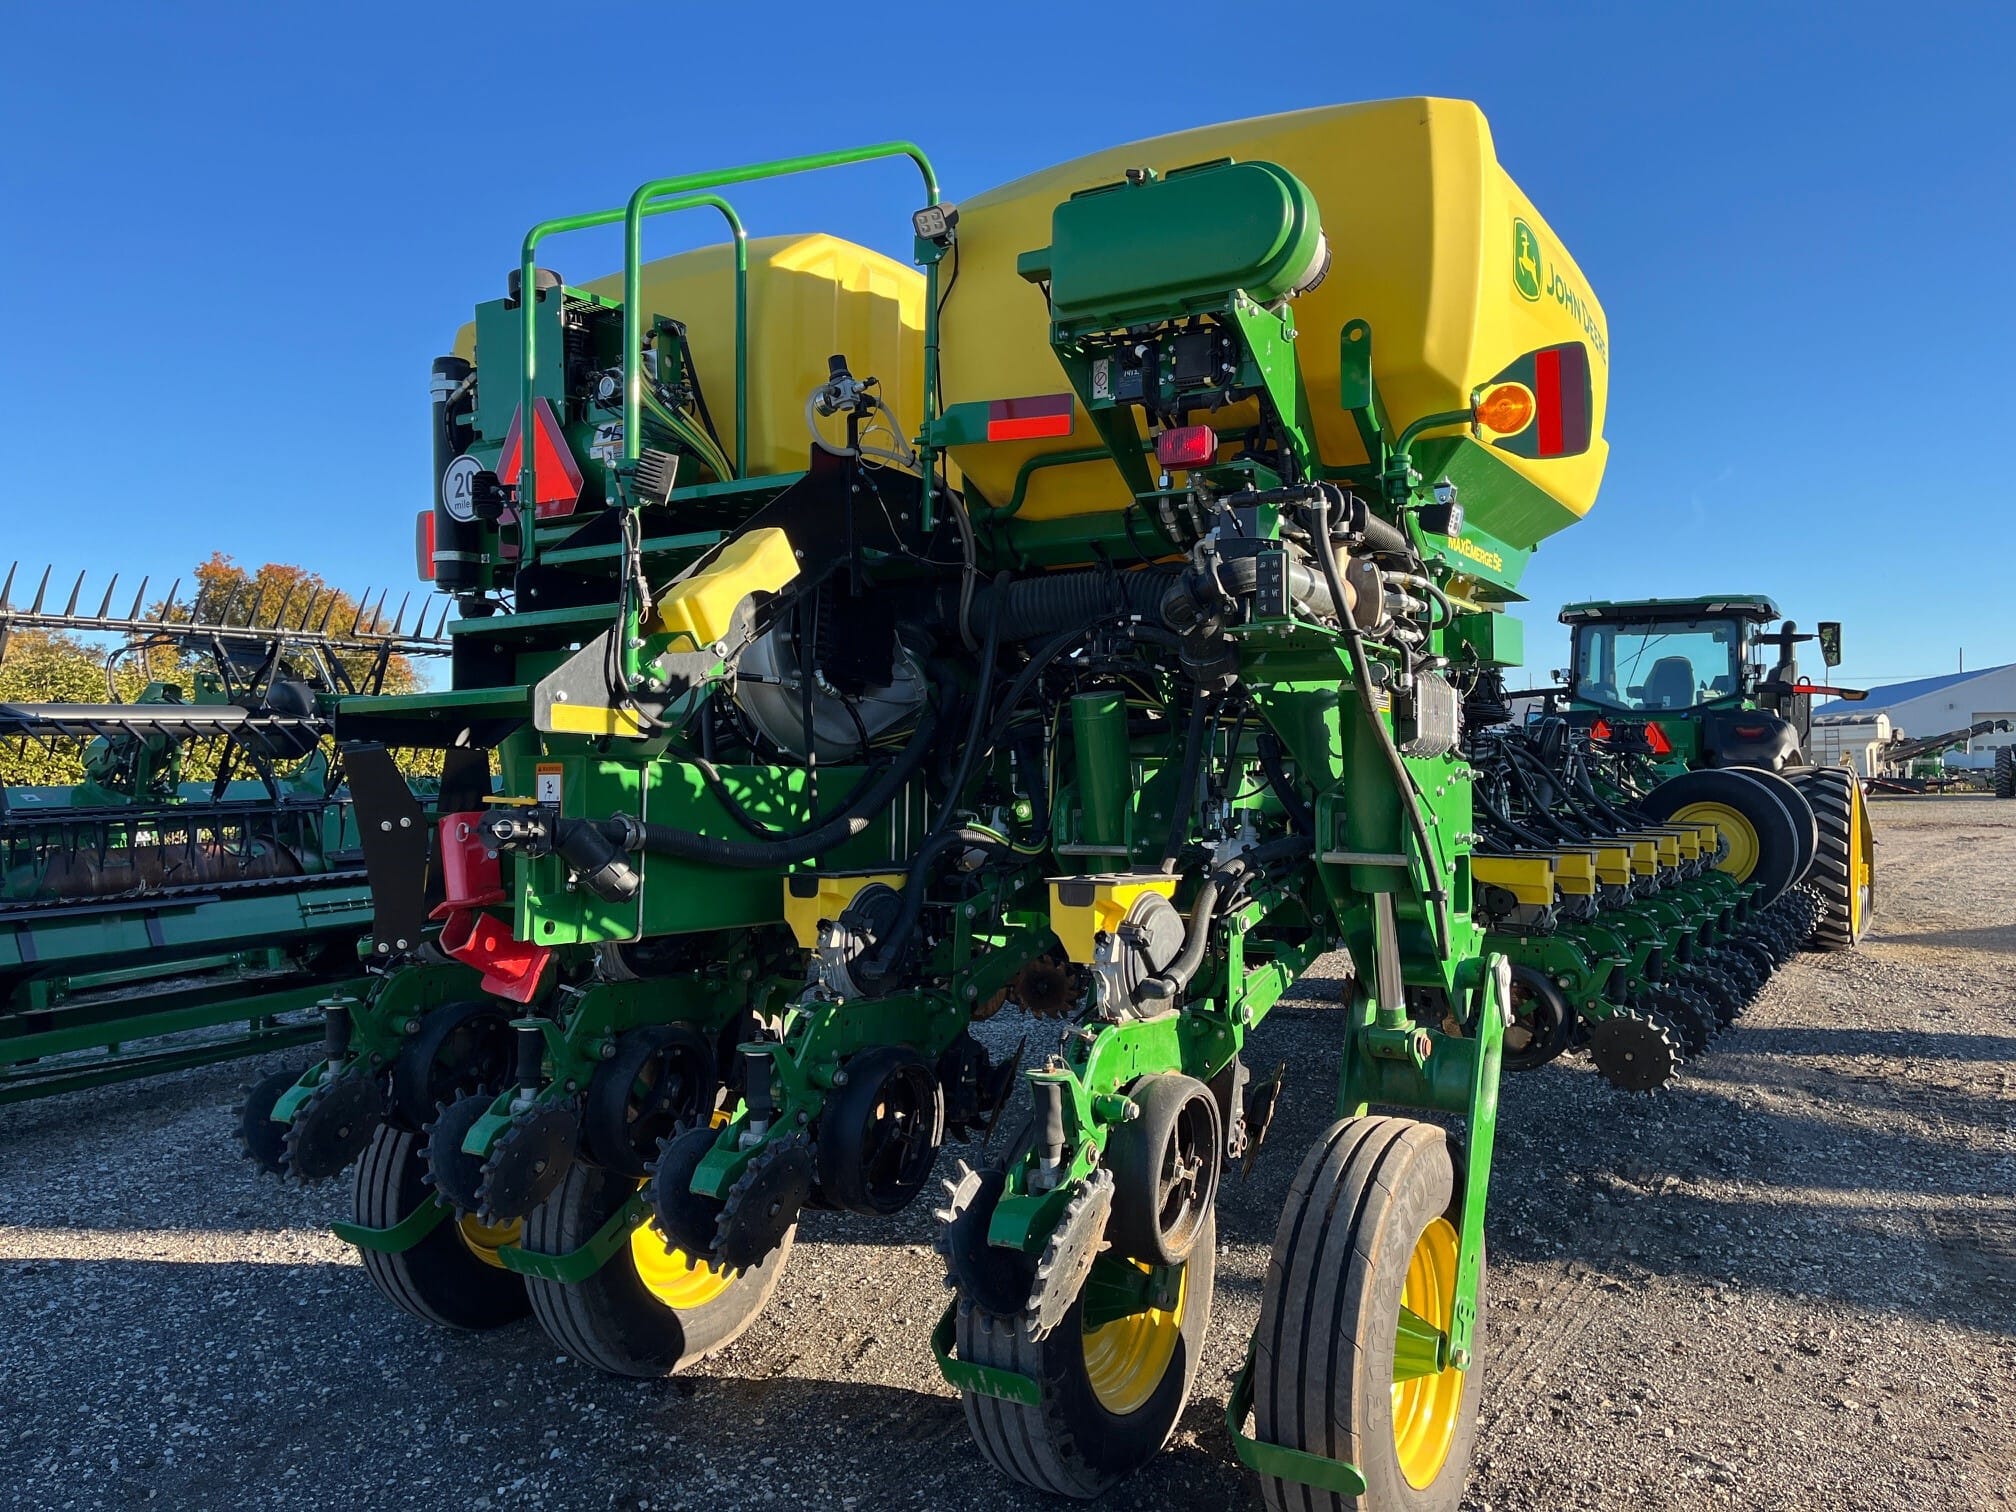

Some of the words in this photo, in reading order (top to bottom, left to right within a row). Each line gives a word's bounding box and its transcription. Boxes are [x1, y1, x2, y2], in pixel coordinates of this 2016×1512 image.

[1547, 262, 1581, 324] JOHN
[454, 471, 473, 498] 20
[454, 499, 472, 510] mile
